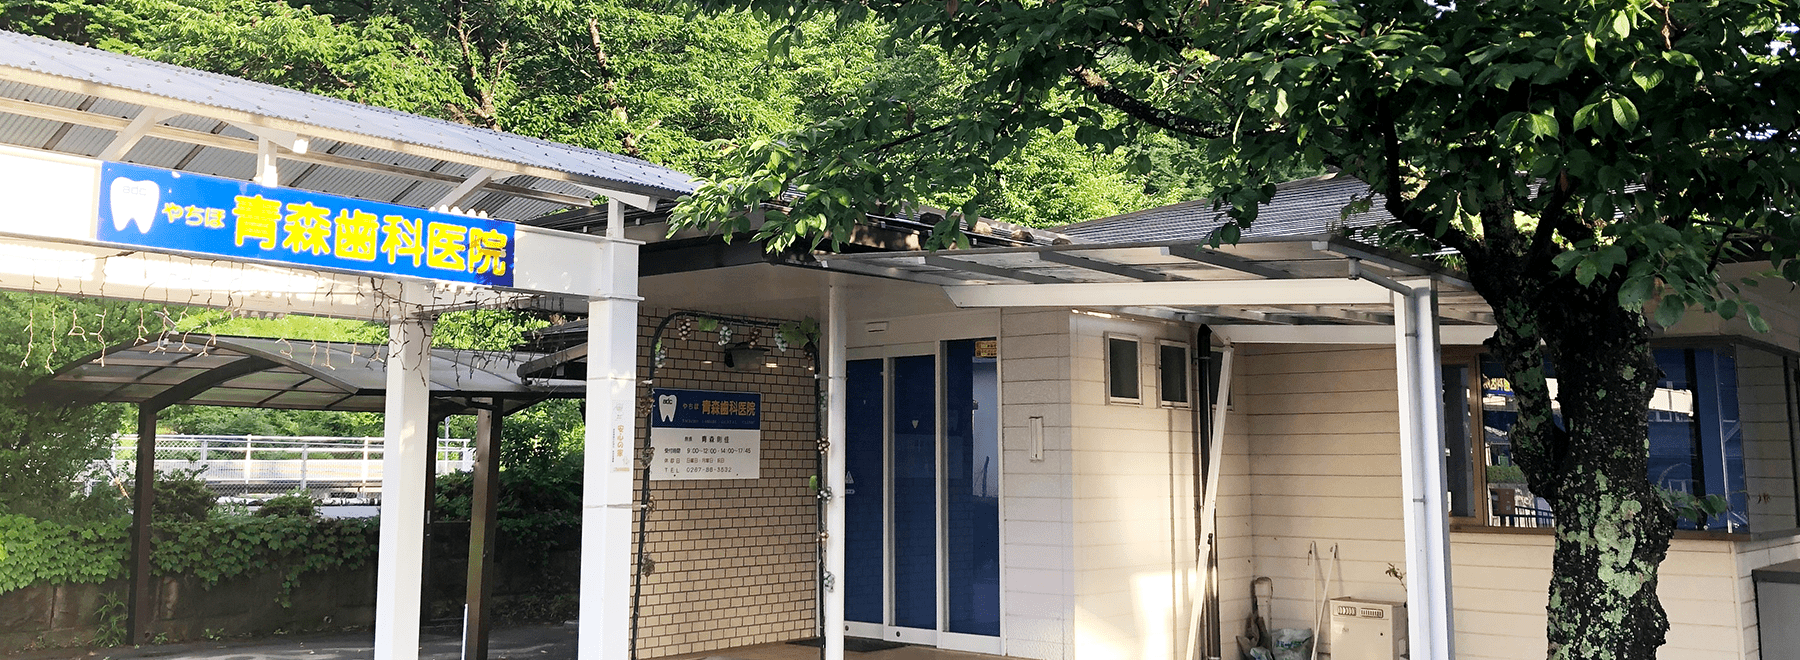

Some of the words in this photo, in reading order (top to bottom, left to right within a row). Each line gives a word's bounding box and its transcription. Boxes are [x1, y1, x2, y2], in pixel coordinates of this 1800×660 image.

[122, 185, 147, 197] adc
[161, 201, 226, 229] やちほ
[232, 194, 509, 277] 青森歯科医院
[702, 400, 756, 416] 青森歯科医院
